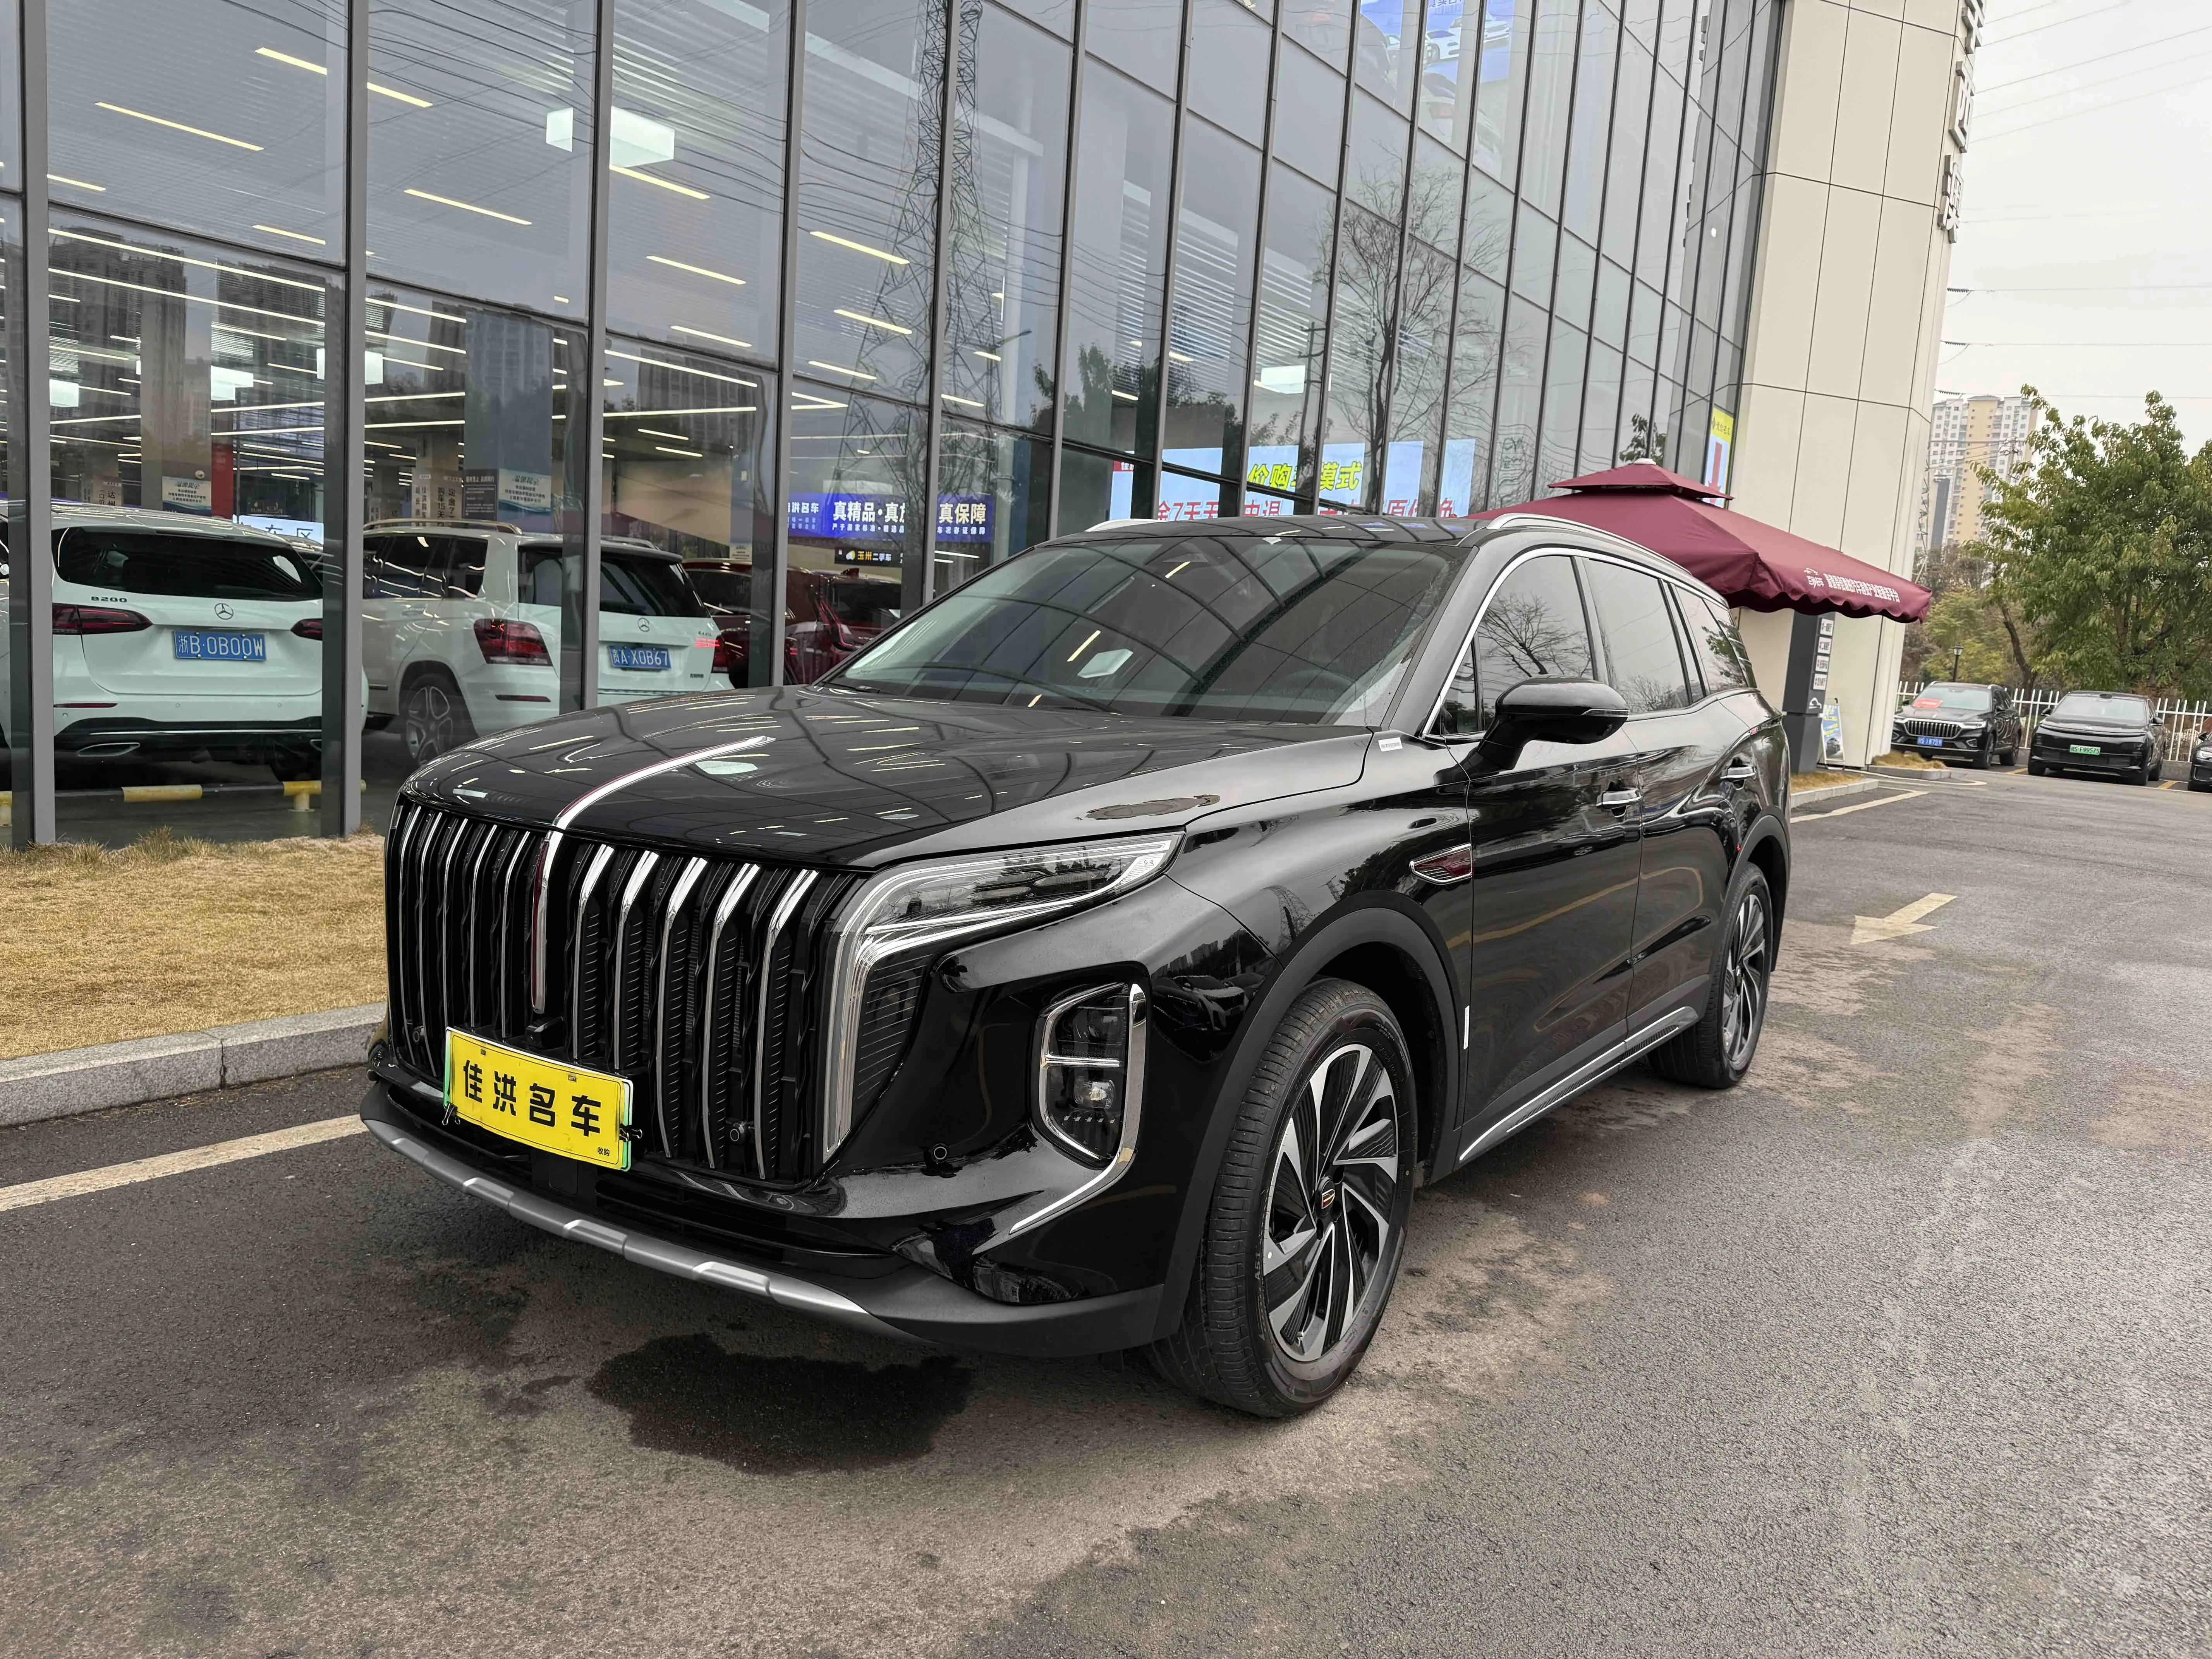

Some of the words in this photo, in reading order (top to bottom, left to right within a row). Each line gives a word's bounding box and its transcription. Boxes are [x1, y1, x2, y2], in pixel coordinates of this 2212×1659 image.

[1247, 463, 1297, 490] 价购
[788, 502, 819, 514] 洪名车
[939, 503, 986, 524] 真保障
[463, 1059, 601, 1137] 佳洪名车
[598, 1147, 610, 1156] 收购
